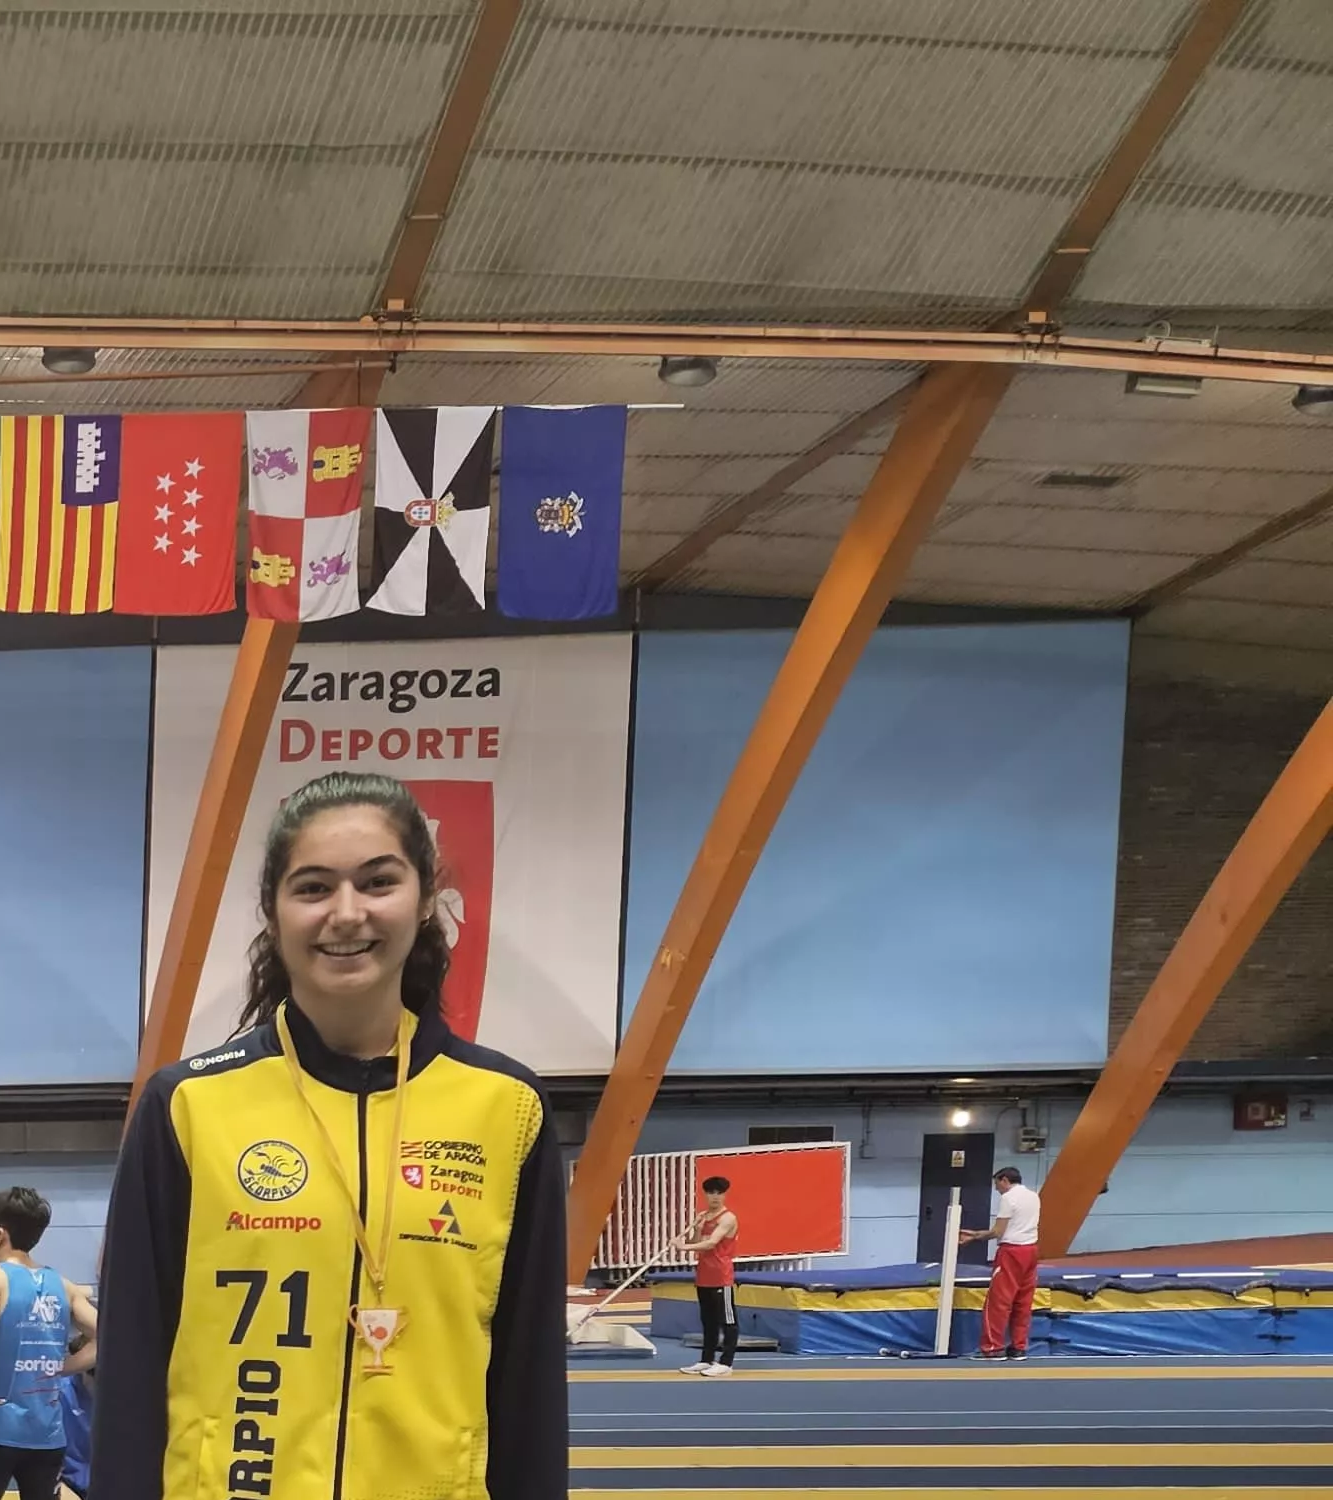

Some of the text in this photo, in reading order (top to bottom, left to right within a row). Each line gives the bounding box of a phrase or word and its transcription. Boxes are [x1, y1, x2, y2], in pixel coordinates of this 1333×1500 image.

[280, 663, 501, 713] Zaragoza
[279, 718, 501, 763] DEPORTE
[424, 1150, 440, 1160] DE
[431, 1165, 484, 1184] Zaragoza
[243, 1176, 293, 1199] SCORPIO
[225, 1210, 322, 1233] Alcampo
[215, 1269, 313, 1349] 71
